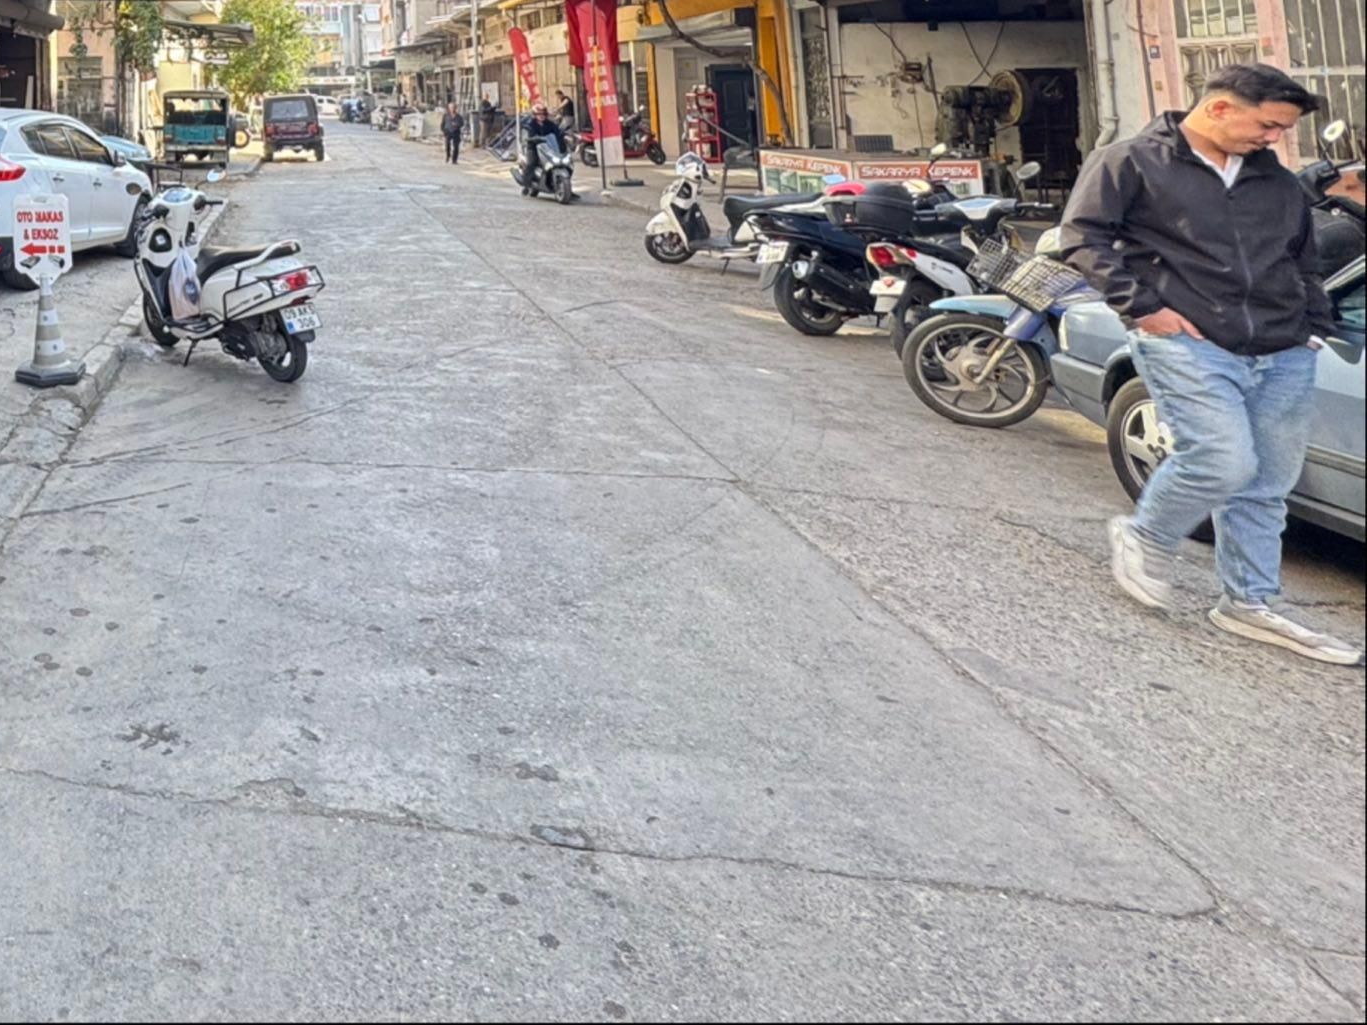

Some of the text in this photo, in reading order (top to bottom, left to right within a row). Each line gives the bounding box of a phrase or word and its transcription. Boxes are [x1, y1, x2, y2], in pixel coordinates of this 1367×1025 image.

[806, 161, 842, 175] KEPENK
[861, 166, 922, 176] SAKARYA
[16, 211, 33, 223] OTO
